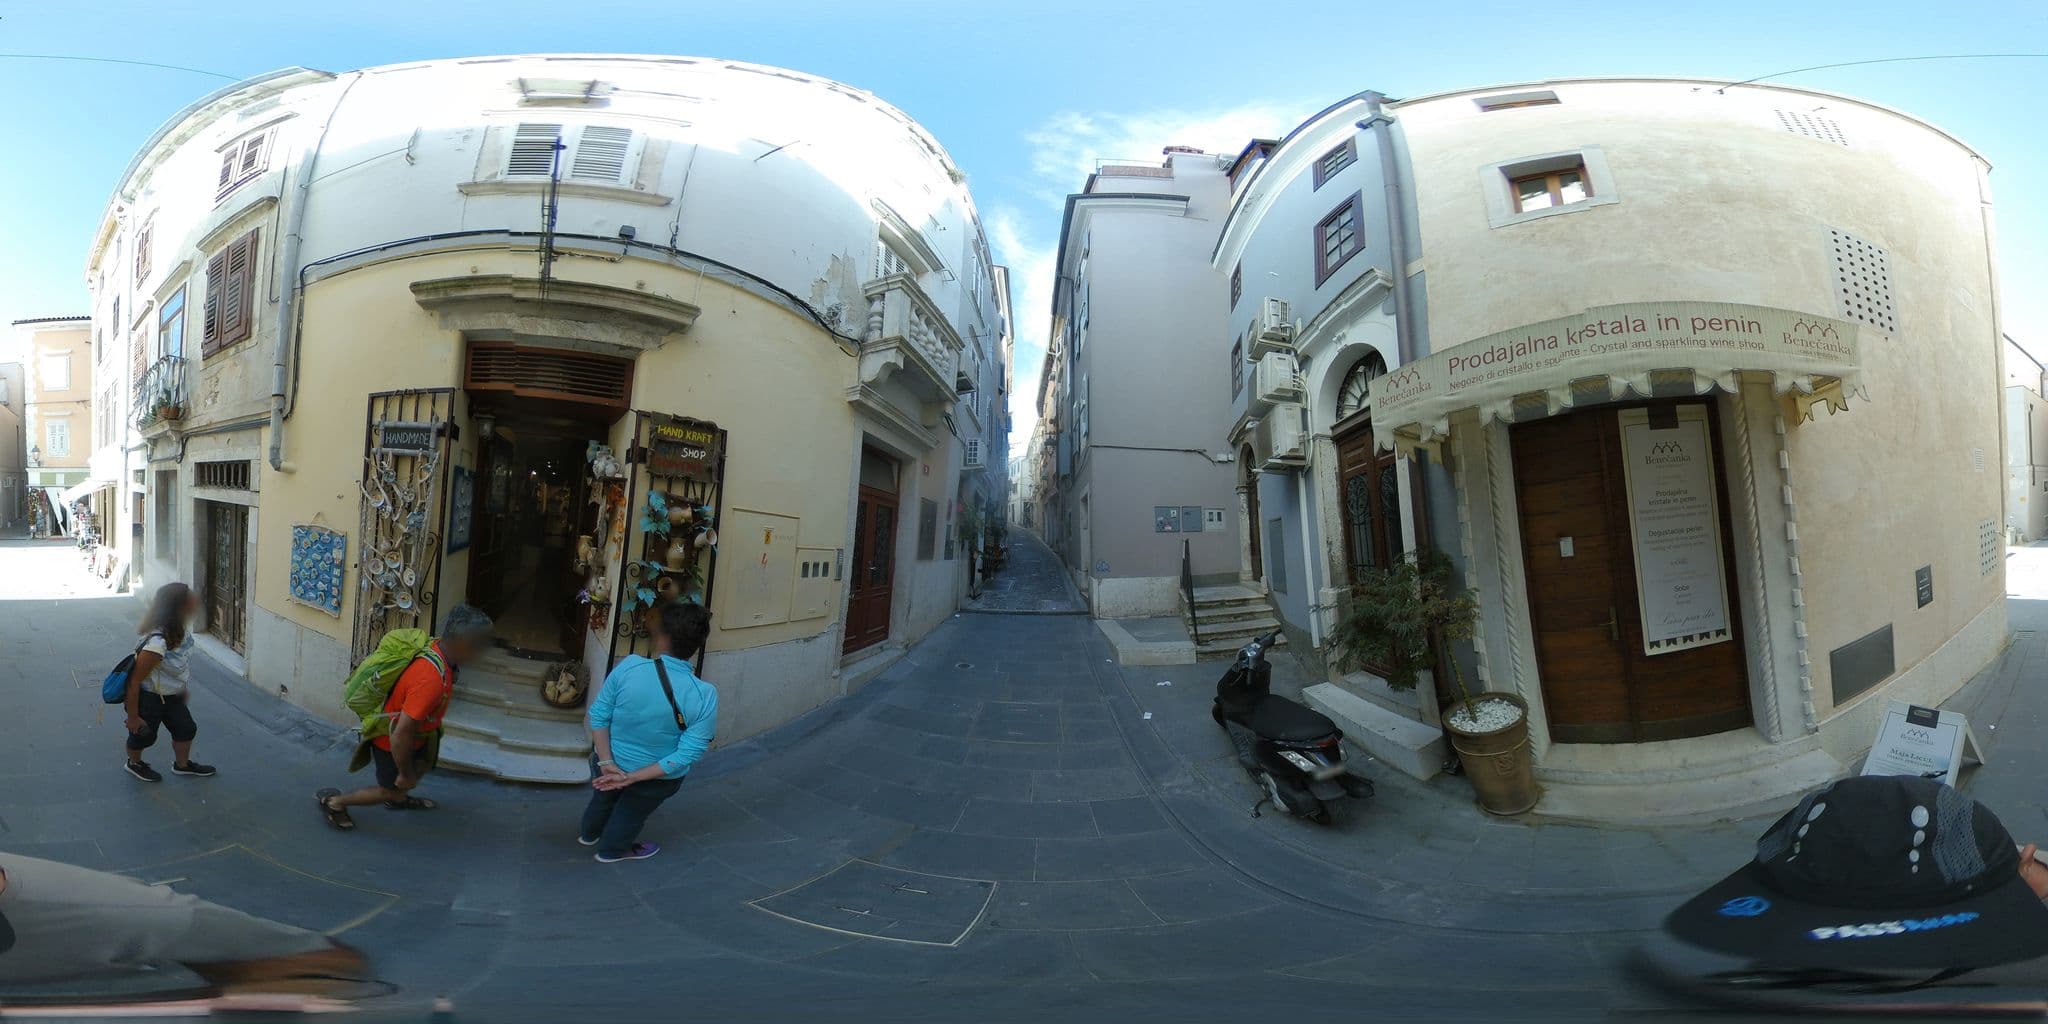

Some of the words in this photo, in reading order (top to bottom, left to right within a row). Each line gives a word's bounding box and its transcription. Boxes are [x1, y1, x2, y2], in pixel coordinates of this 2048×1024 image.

[1449, 336, 1558, 375] Prodajalna
[1656, 314, 1680, 330] in
[1691, 315, 1762, 335] penin
[1783, 332, 1851, 355] Benečanka
[1449, 374, 1485, 391] Negozio
[1486, 369, 1496, 380] di
[1497, 361, 1534, 378] cristallo
[1535, 360, 1542, 368] e
[1590, 340, 1628, 354] Crystal
[1631, 337, 1652, 350] and
[1655, 337, 1706, 349] sparkling
[1710, 338, 1735, 348] wine
[1738, 339, 1765, 351] shop
[1379, 382, 1432, 409] Benečanka
[385, 431, 431, 446] HANDMADE
[655, 424, 684, 439] HAND
[686, 430, 713, 444] KRAFT
[681, 447, 707, 460] SHOP
